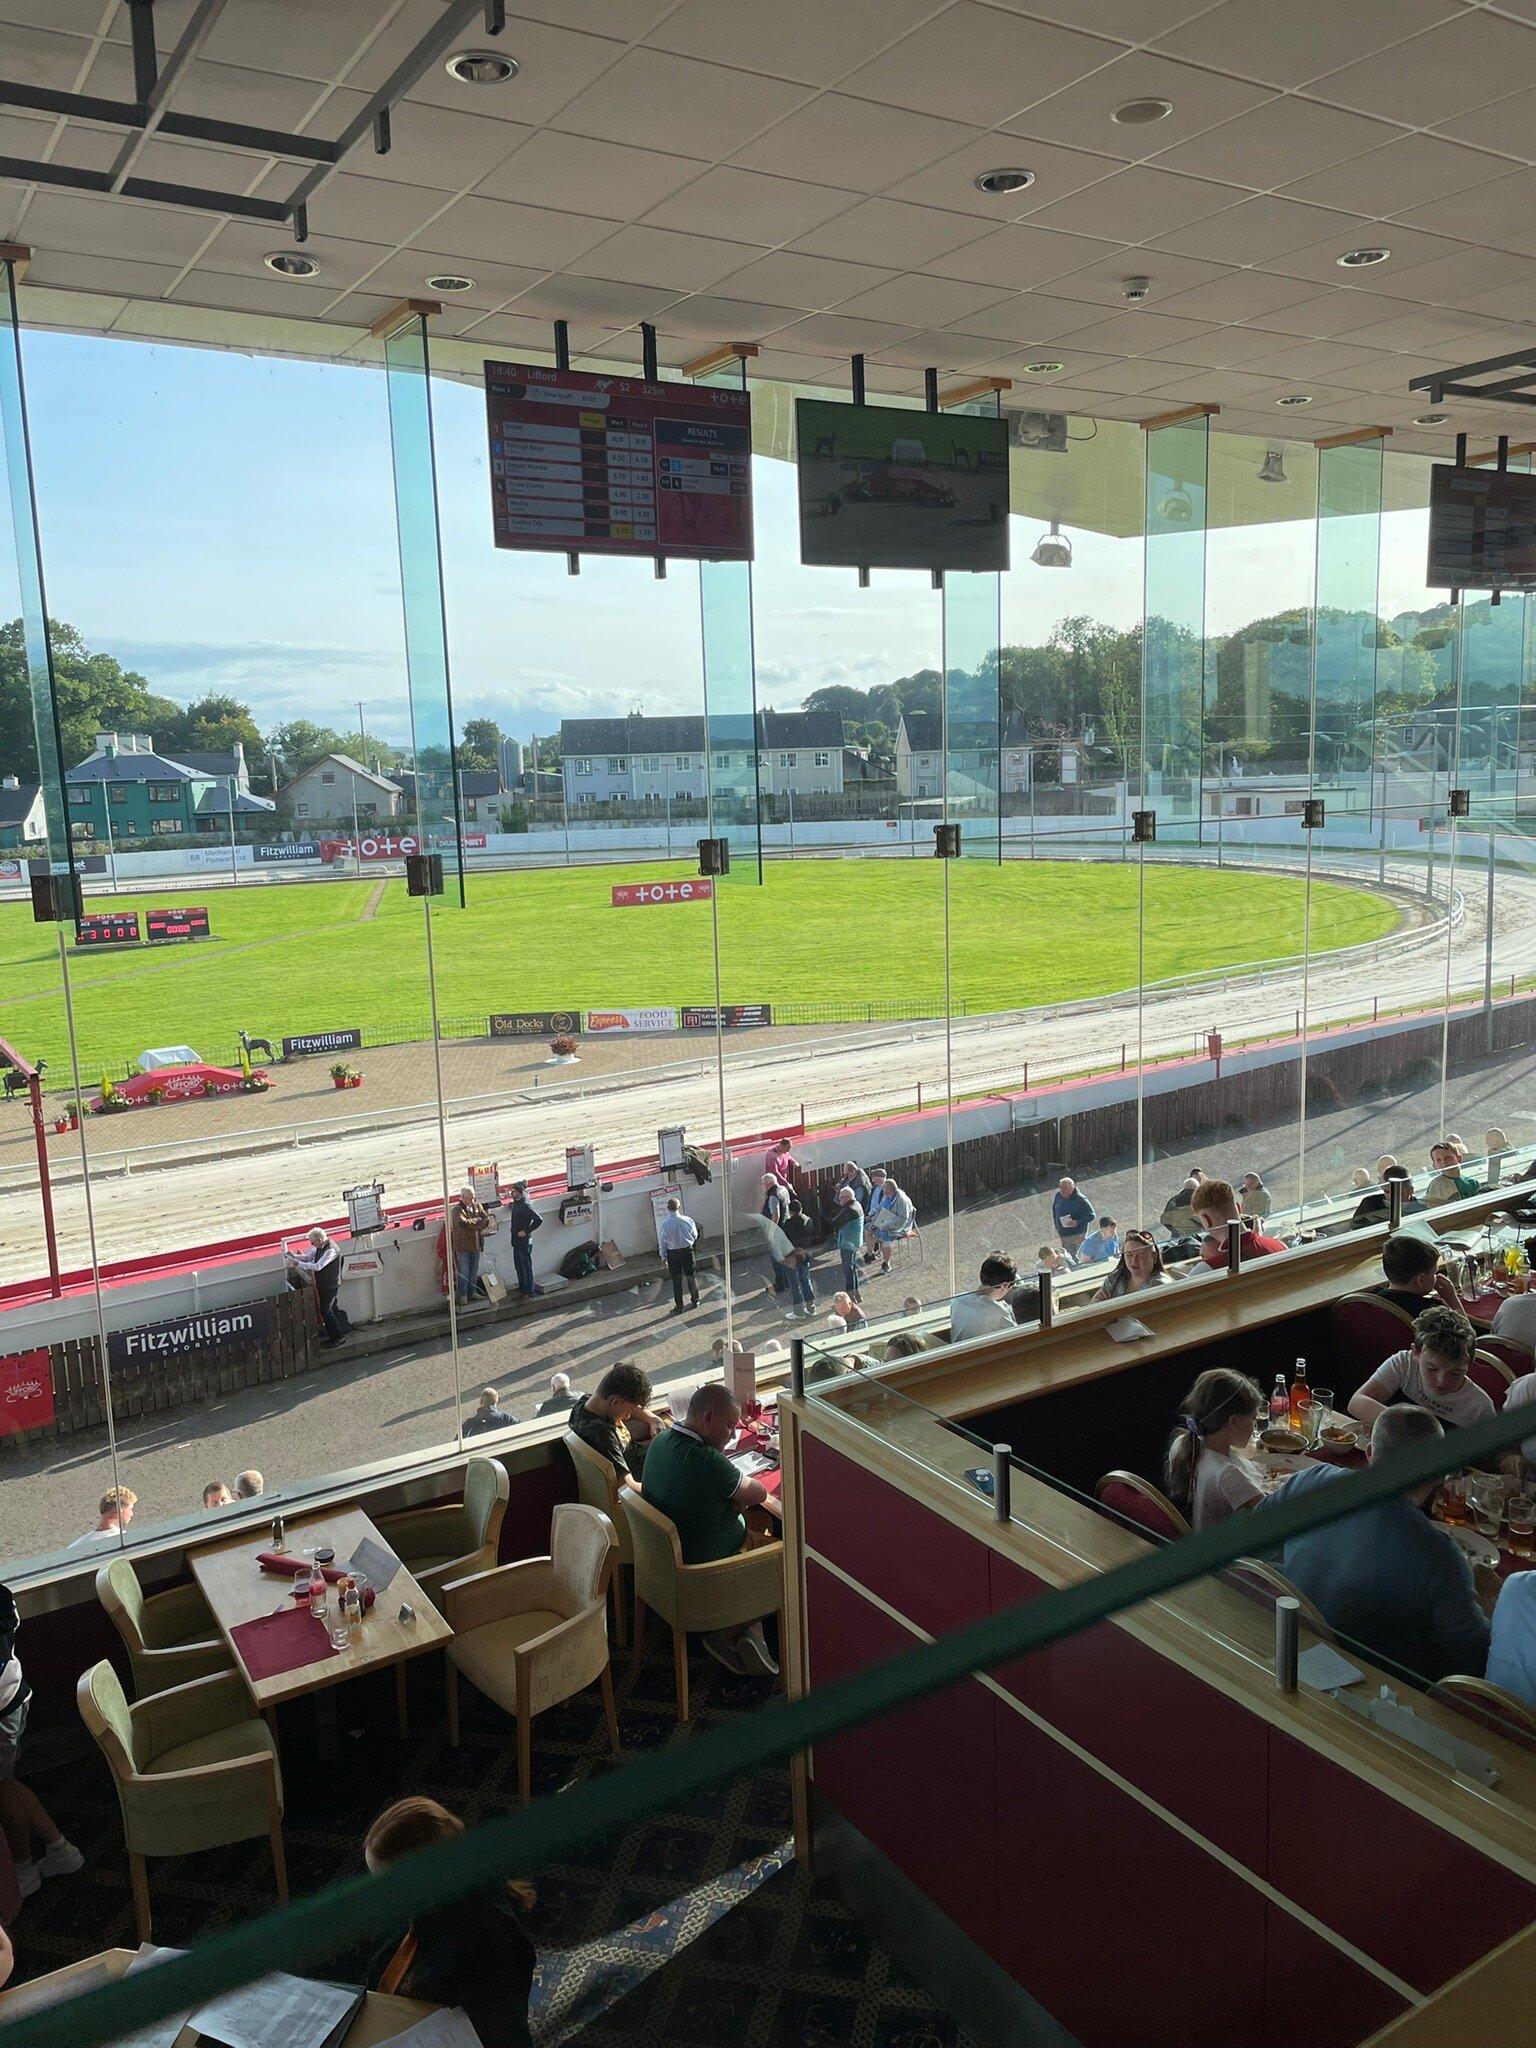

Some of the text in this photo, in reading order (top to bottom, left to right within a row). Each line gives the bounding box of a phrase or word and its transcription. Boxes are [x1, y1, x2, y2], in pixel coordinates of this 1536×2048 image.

[527, 369, 557, 382] Lifford
[620, 382, 630, 392] S2
[642, 385, 666, 397] 325m
[687, 427, 718, 439] RESULTS
[260, 845, 314, 856] Fitzwilliam
[341, 836, 417, 857] tote
[635, 883, 693, 902] tote
[589, 1014, 623, 1028] Express
[639, 1011, 667, 1020] FOOD
[495, 1019, 512, 1029] Old
[516, 1018, 544, 1029] Docks
[634, 1018, 672, 1029] SERVICE
[290, 1033, 353, 1050] Fitzwilliam
[170, 1079, 199, 1090] LIFFORD
[126, 1312, 253, 1355] Fitzwilliam
[162, 1337, 221, 1356] SPORTS
